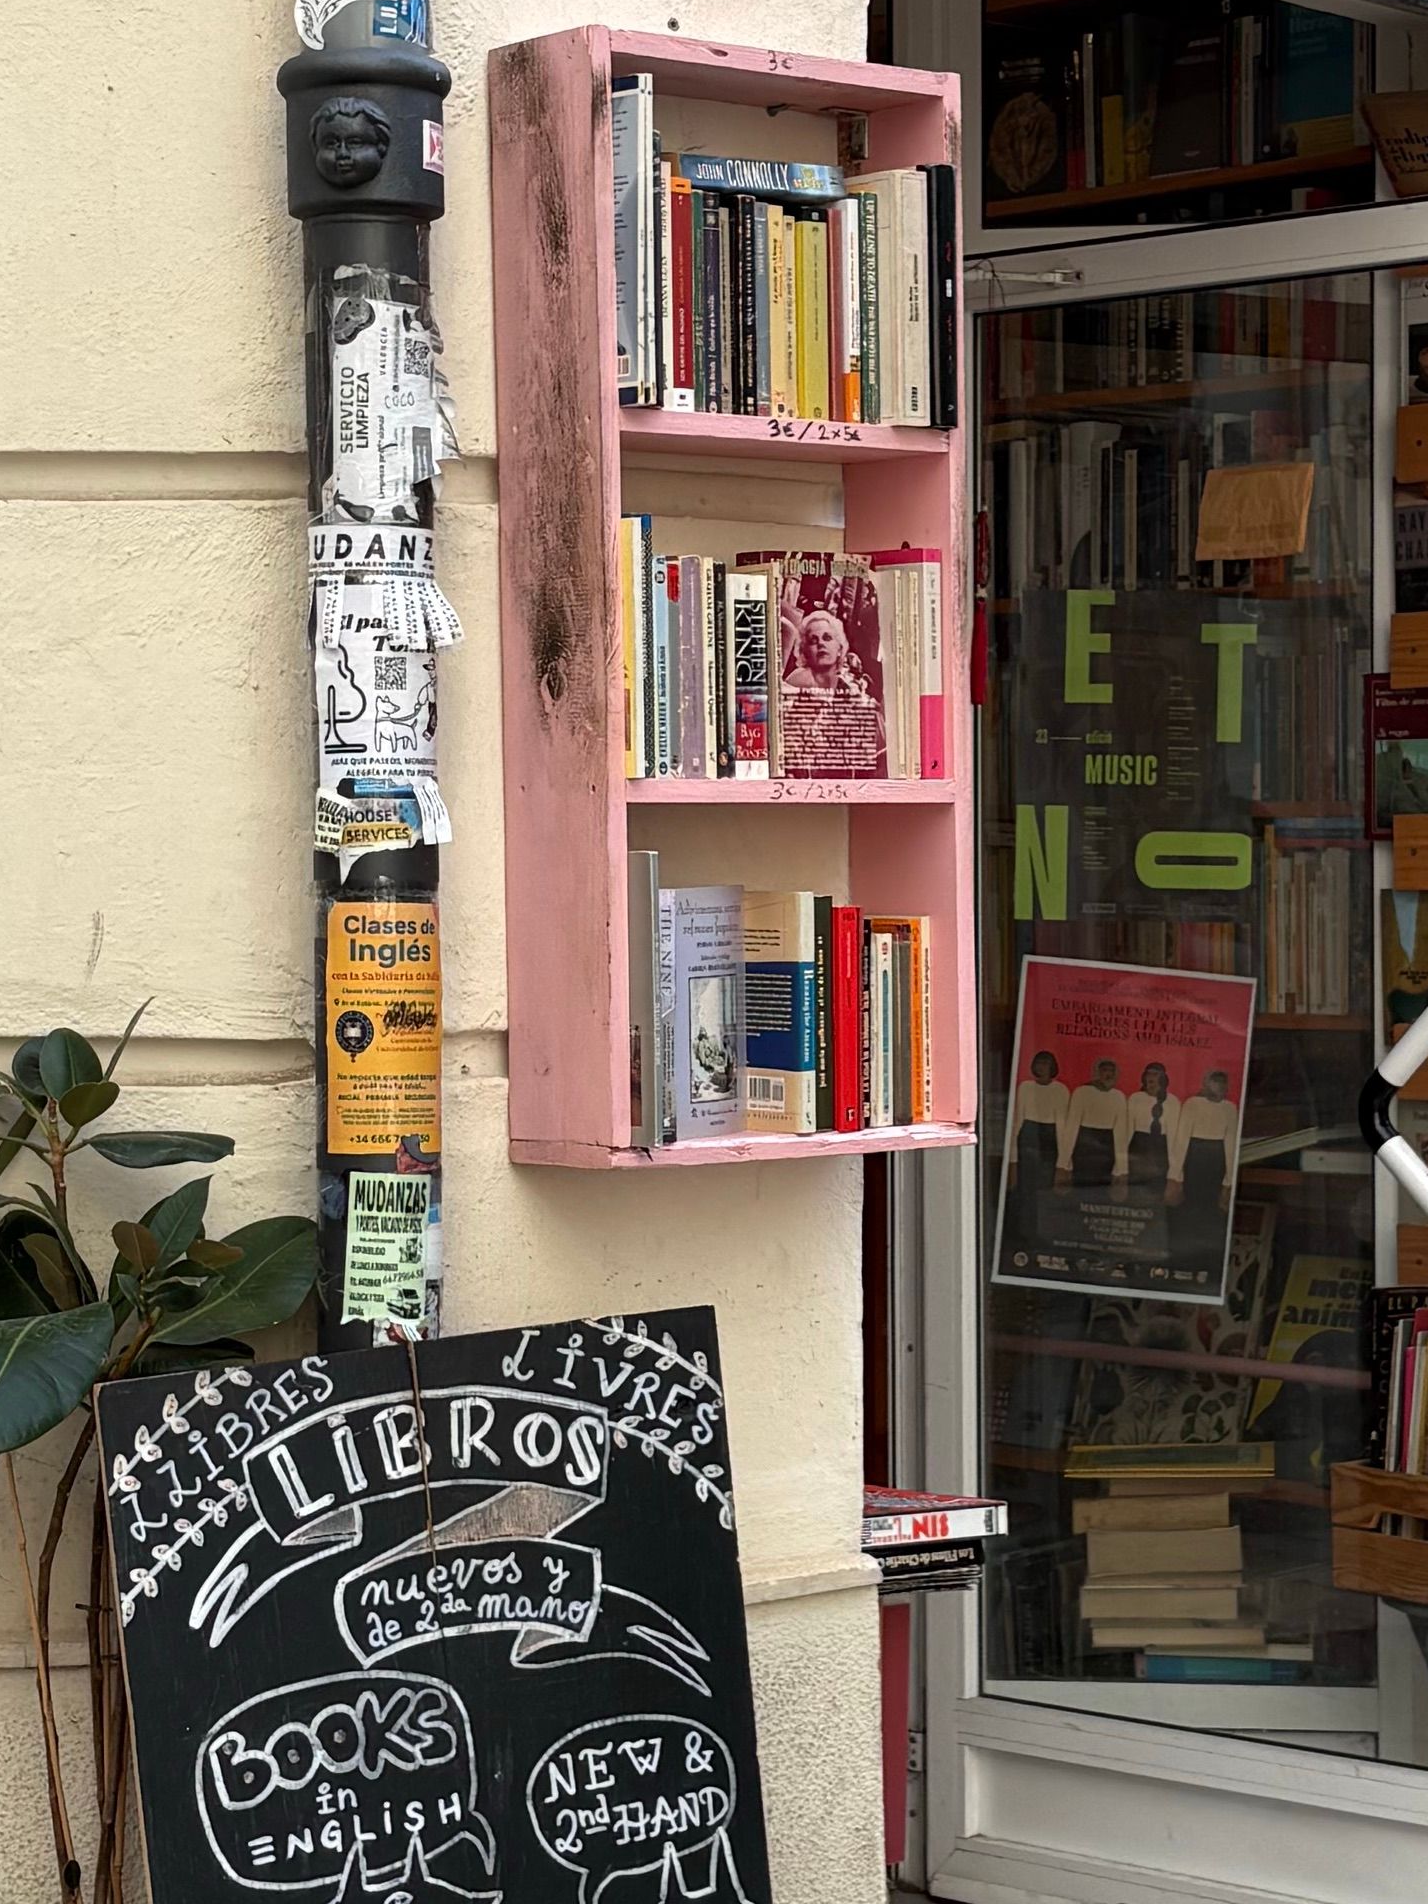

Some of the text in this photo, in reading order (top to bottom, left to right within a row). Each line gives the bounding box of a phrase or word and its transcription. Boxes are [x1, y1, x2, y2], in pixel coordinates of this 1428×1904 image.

[695, 159, 790, 192] JOHN CONNOLLY
[340, 366, 355, 454] SERVICIO
[355, 372, 370, 449] LIMPIEZA
[734, 601, 752, 684] KING
[750, 600, 767, 683] STEPHEN
[1083, 753, 1159, 786] MUSIC
[345, 826, 410, 844] SERVICES
[346, 809, 392, 823] HOUSE
[343, 914, 436, 935] Clases de
[349, 938, 432, 968] Inglés
[353, 1179, 427, 1215] MUDANZAS
[501, 1329, 715, 1446] LIVRES
[122, 1355, 337, 1543] LLIBRES
[269, 1395, 606, 1520] LIBROS
[359, 1551, 571, 1608] nuevos y
[366, 1610, 403, 1650] de
[476, 1591, 593, 1625] mano
[208, 1686, 458, 1811] BOOKS
[541, 1730, 715, 1806] NEW &
[314, 1783, 359, 1816] in
[554, 1786, 730, 1855] 2nd HAND
